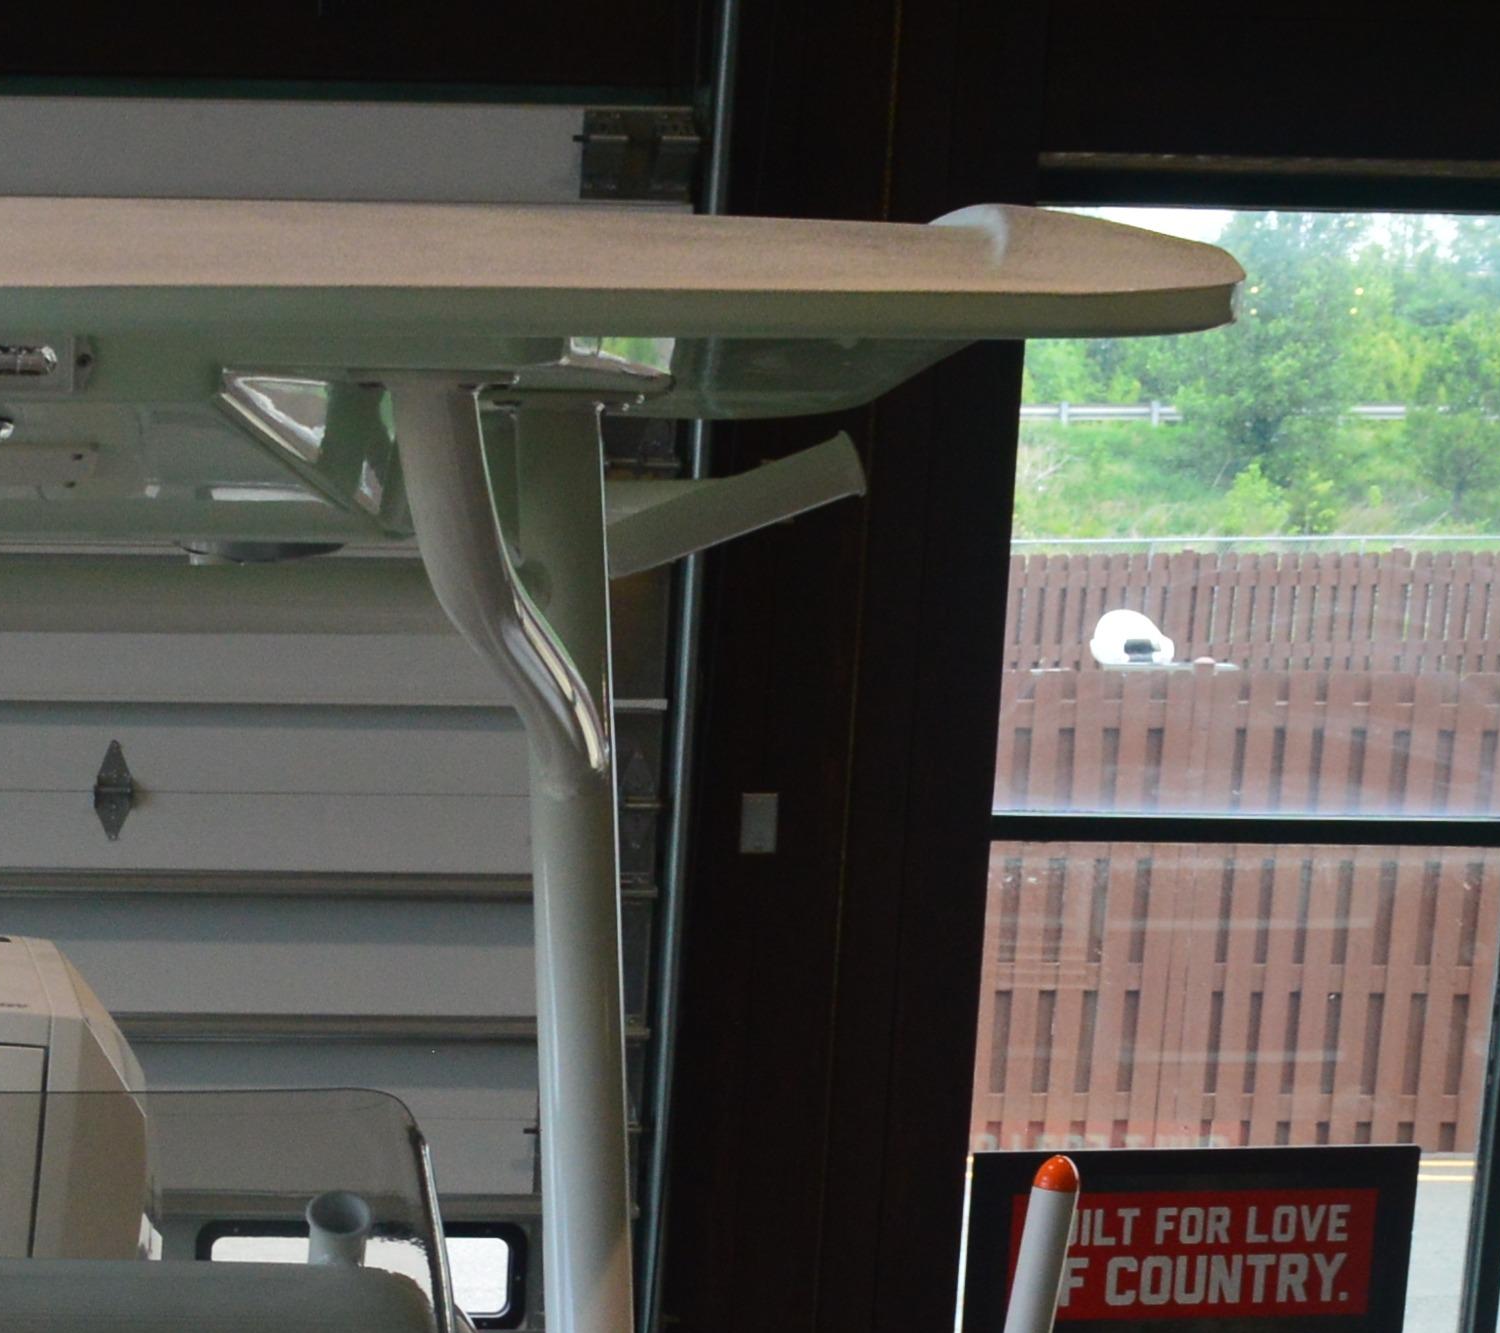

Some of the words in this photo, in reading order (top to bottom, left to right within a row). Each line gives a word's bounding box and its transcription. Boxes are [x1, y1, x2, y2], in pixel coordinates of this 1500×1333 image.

[1069, 1207, 1140, 1246] ILT
[1155, 1206, 1229, 1245] FOR
[1245, 1204, 1351, 1243] LOVE
[1057, 1257, 1090, 1307] F
[1104, 1252, 1349, 1306] COUNTRY.
